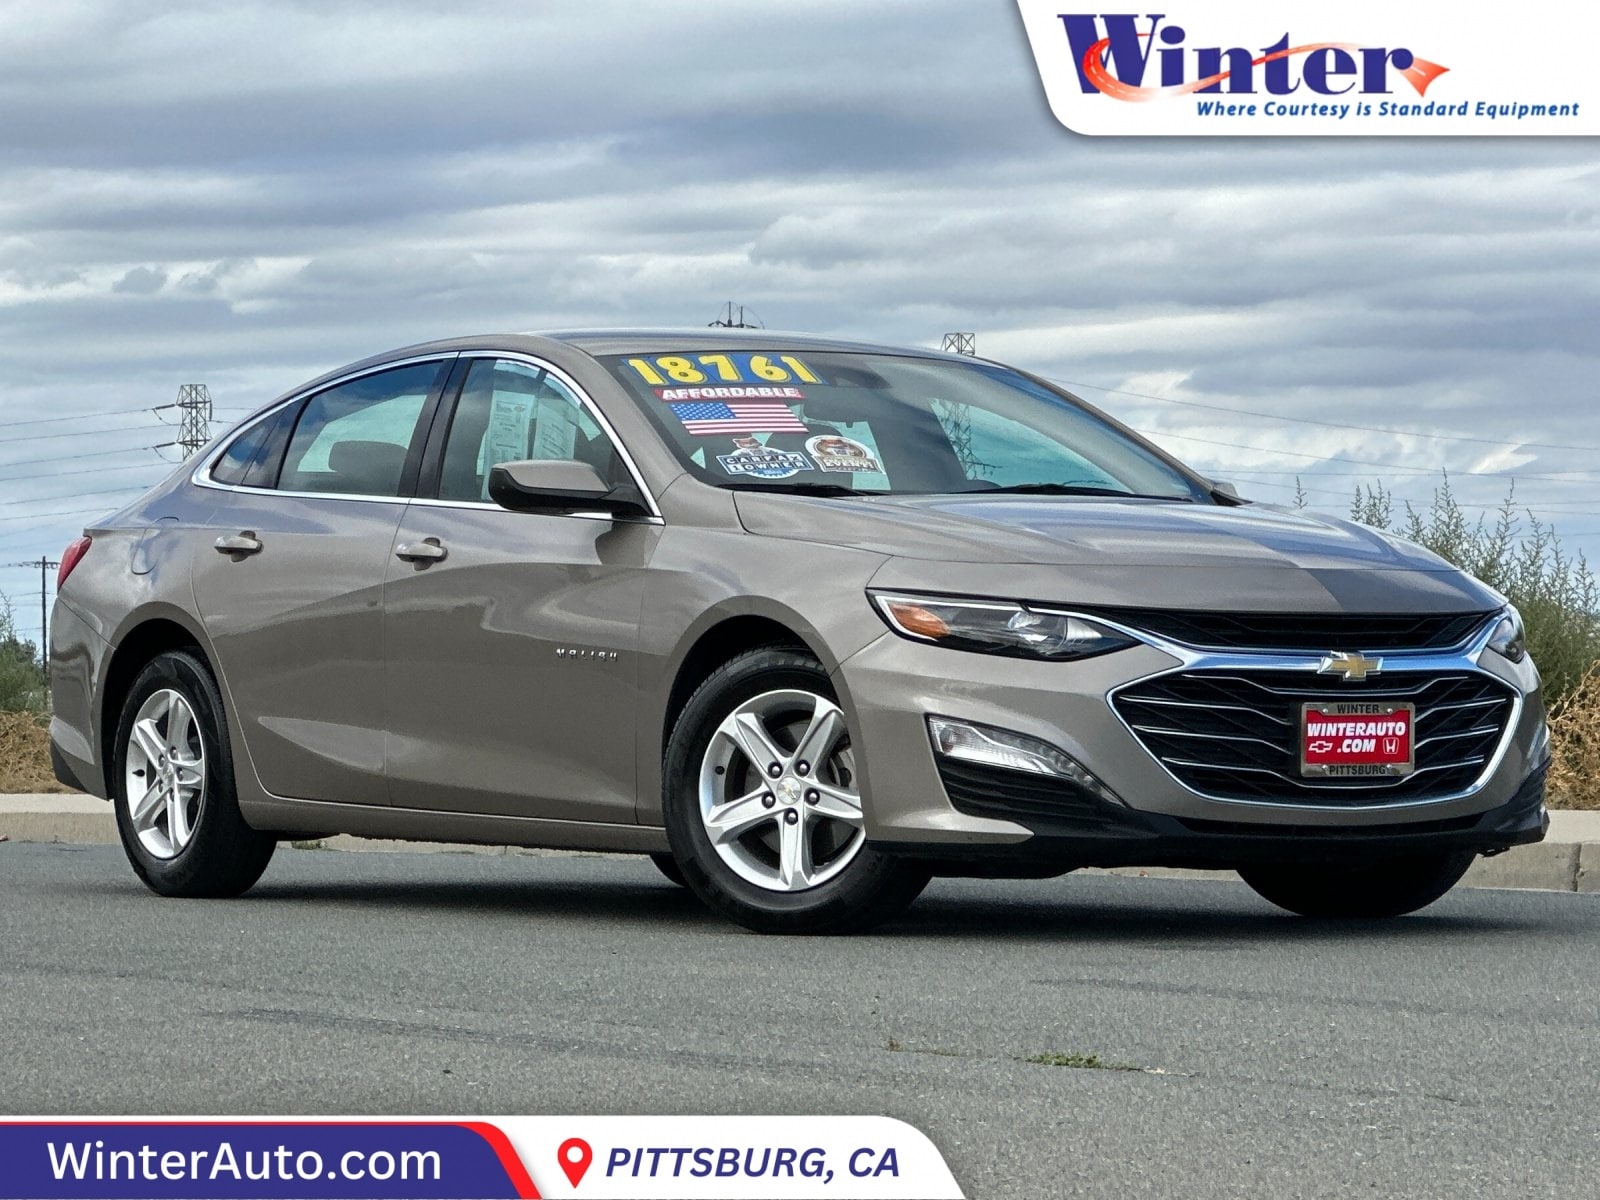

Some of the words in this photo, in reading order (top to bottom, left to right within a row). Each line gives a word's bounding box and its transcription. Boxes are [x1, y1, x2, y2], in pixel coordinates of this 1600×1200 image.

[662, 387, 801, 400] AFFORDABLE
[725, 454, 801, 465] CARFAX
[744, 461, 806, 471] OWNER
[1337, 704, 1380, 714] WINTER
[1307, 721, 1406, 737] WINTERAUTO
[1337, 738, 1376, 753] .COM
[1329, 764, 1386, 775] PITTSBURG
